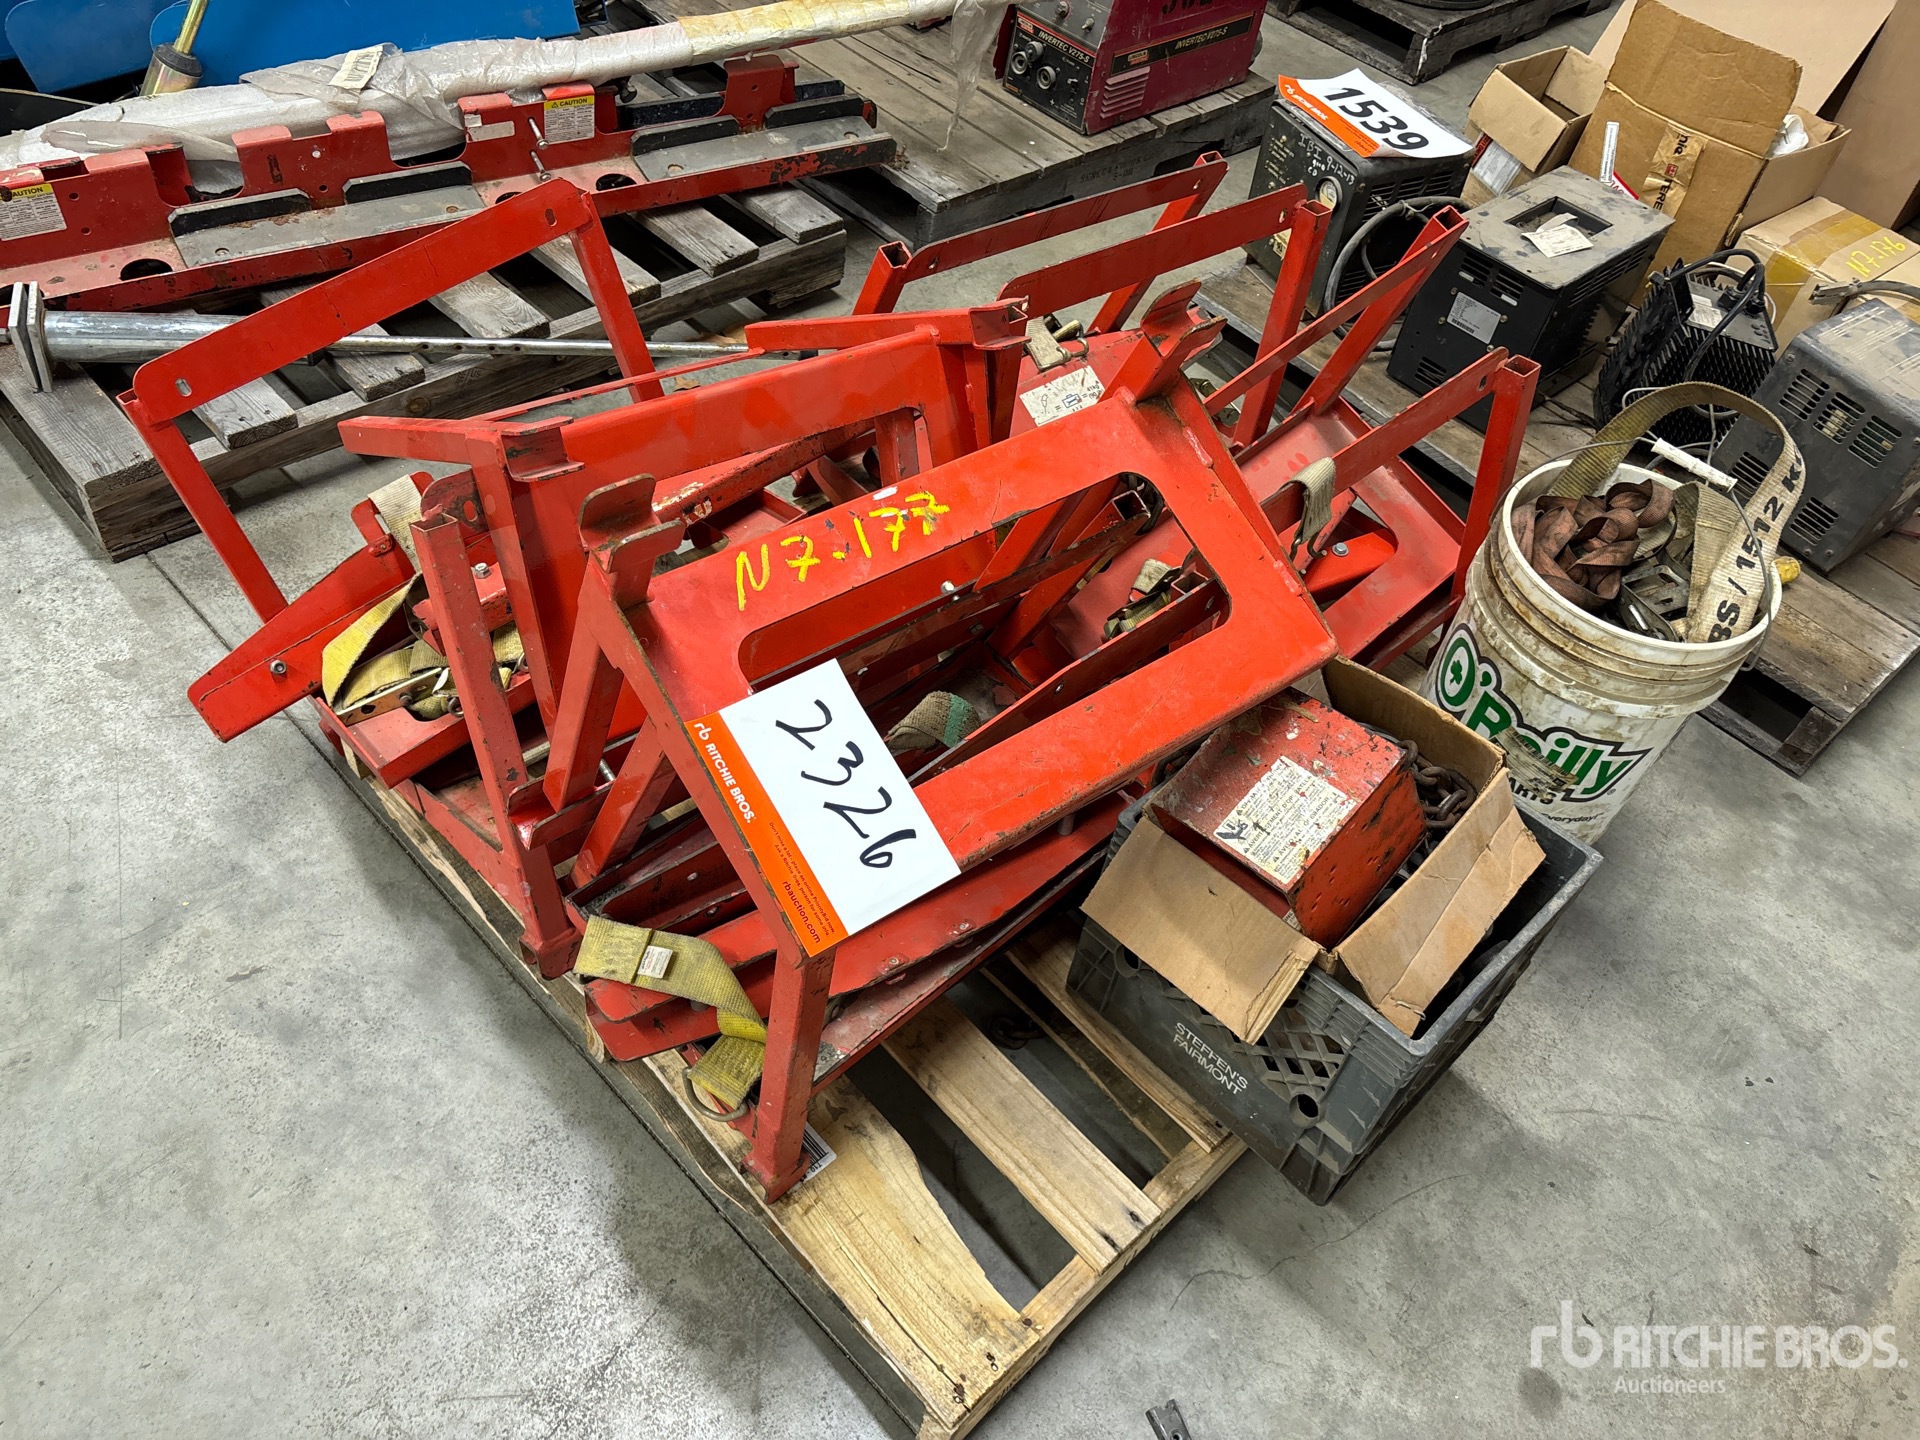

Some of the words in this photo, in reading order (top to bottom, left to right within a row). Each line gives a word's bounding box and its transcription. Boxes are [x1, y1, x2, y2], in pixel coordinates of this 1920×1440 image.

[1038, 30, 1068, 52] INVERTEC
[1068, 46, 1091, 63] V275-S
[1175, 33, 1208, 50] INVERTEC
[560, 98, 588, 107] CAUTION
[1324, 87, 1430, 151] 1539
[12, 186, 44, 198] AUTION
[1653, 178, 1672, 211] TERE
[1781, 452, 1803, 493] K
[1736, 496, 1785, 571] 1512
[1727, 577, 1747, 595] /
[1707, 599, 1741, 643] BS
[693, 722, 712, 742] rb
[705, 743, 737, 793] RITCHIE
[775, 699, 917, 869] 2326
[1508, 776, 1558, 806] ARTS
[781, 879, 823, 943] rbauction.com
[1173, 1034, 1243, 1095] FAIRMONT
[1174, 1022, 1249, 1090] STEFFEN'S
